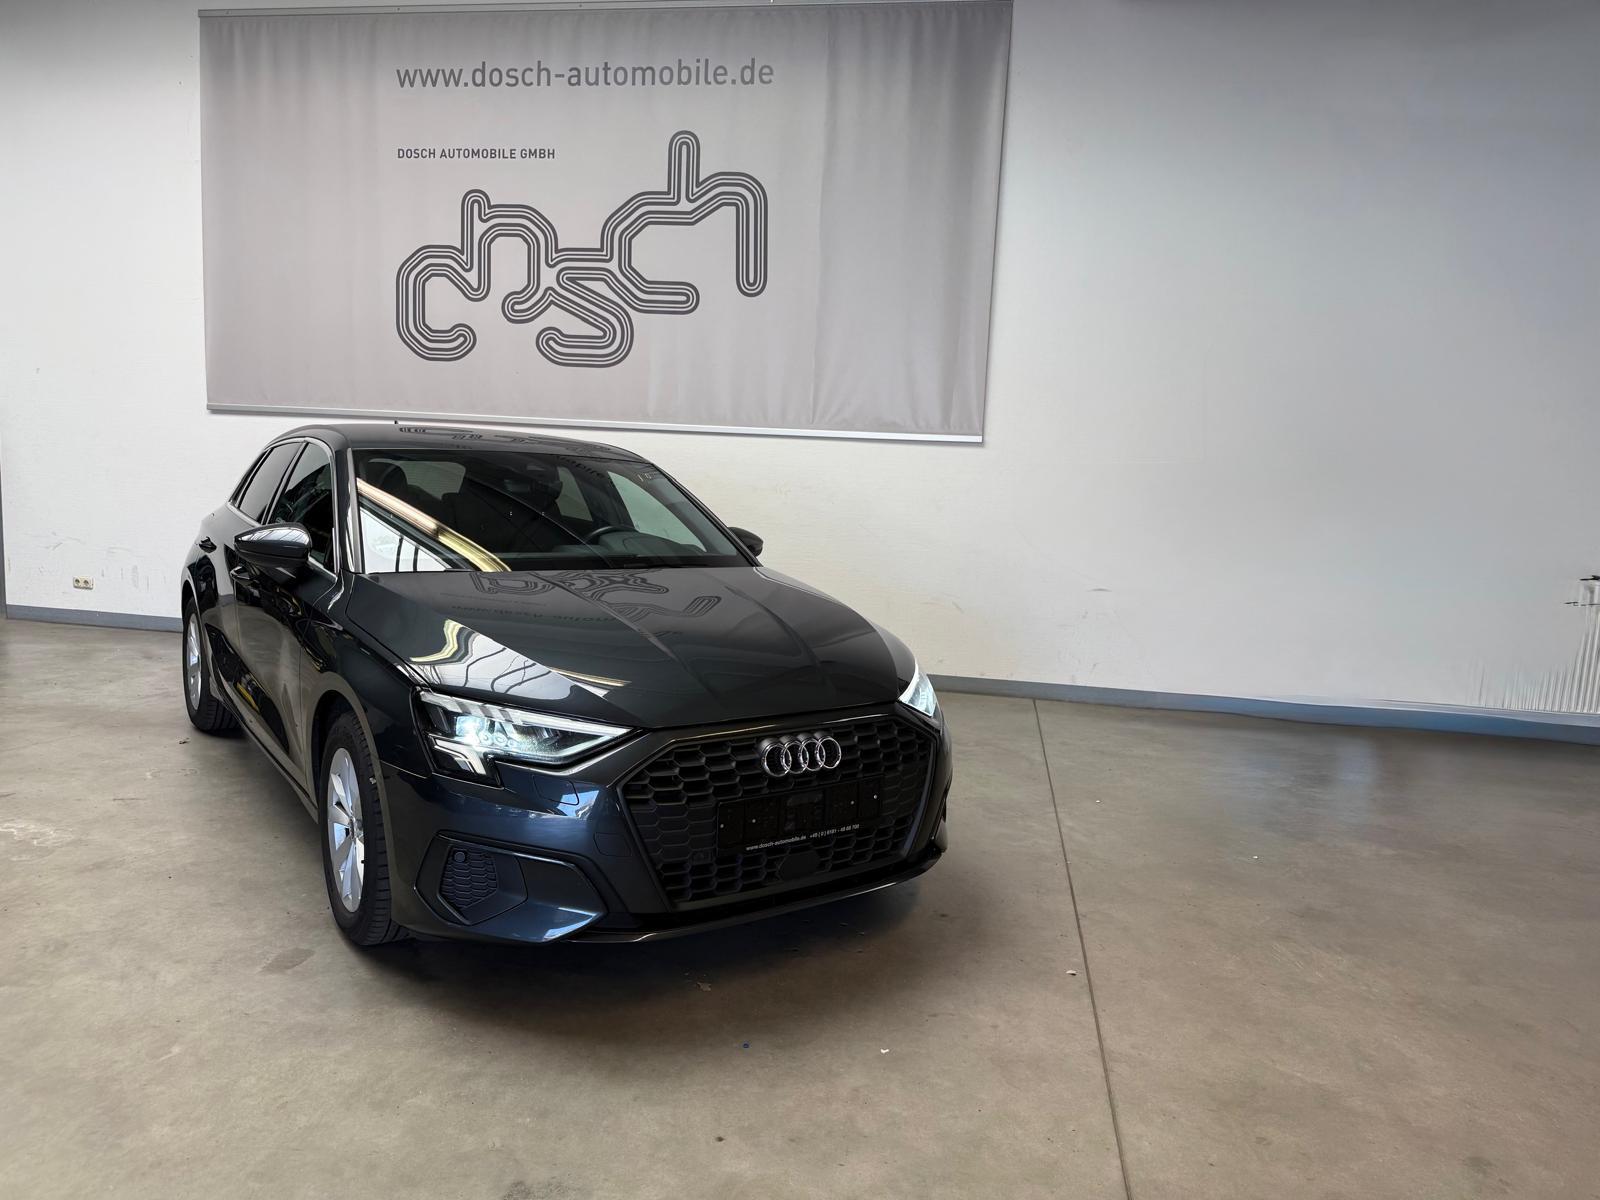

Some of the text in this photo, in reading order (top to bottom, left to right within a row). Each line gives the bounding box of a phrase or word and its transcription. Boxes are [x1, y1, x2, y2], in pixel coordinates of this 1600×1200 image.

[396, 57, 775, 88] www.dosch-automobile.de
[396, 147, 556, 161] DOSCH AUTOMOBILE GMBH
